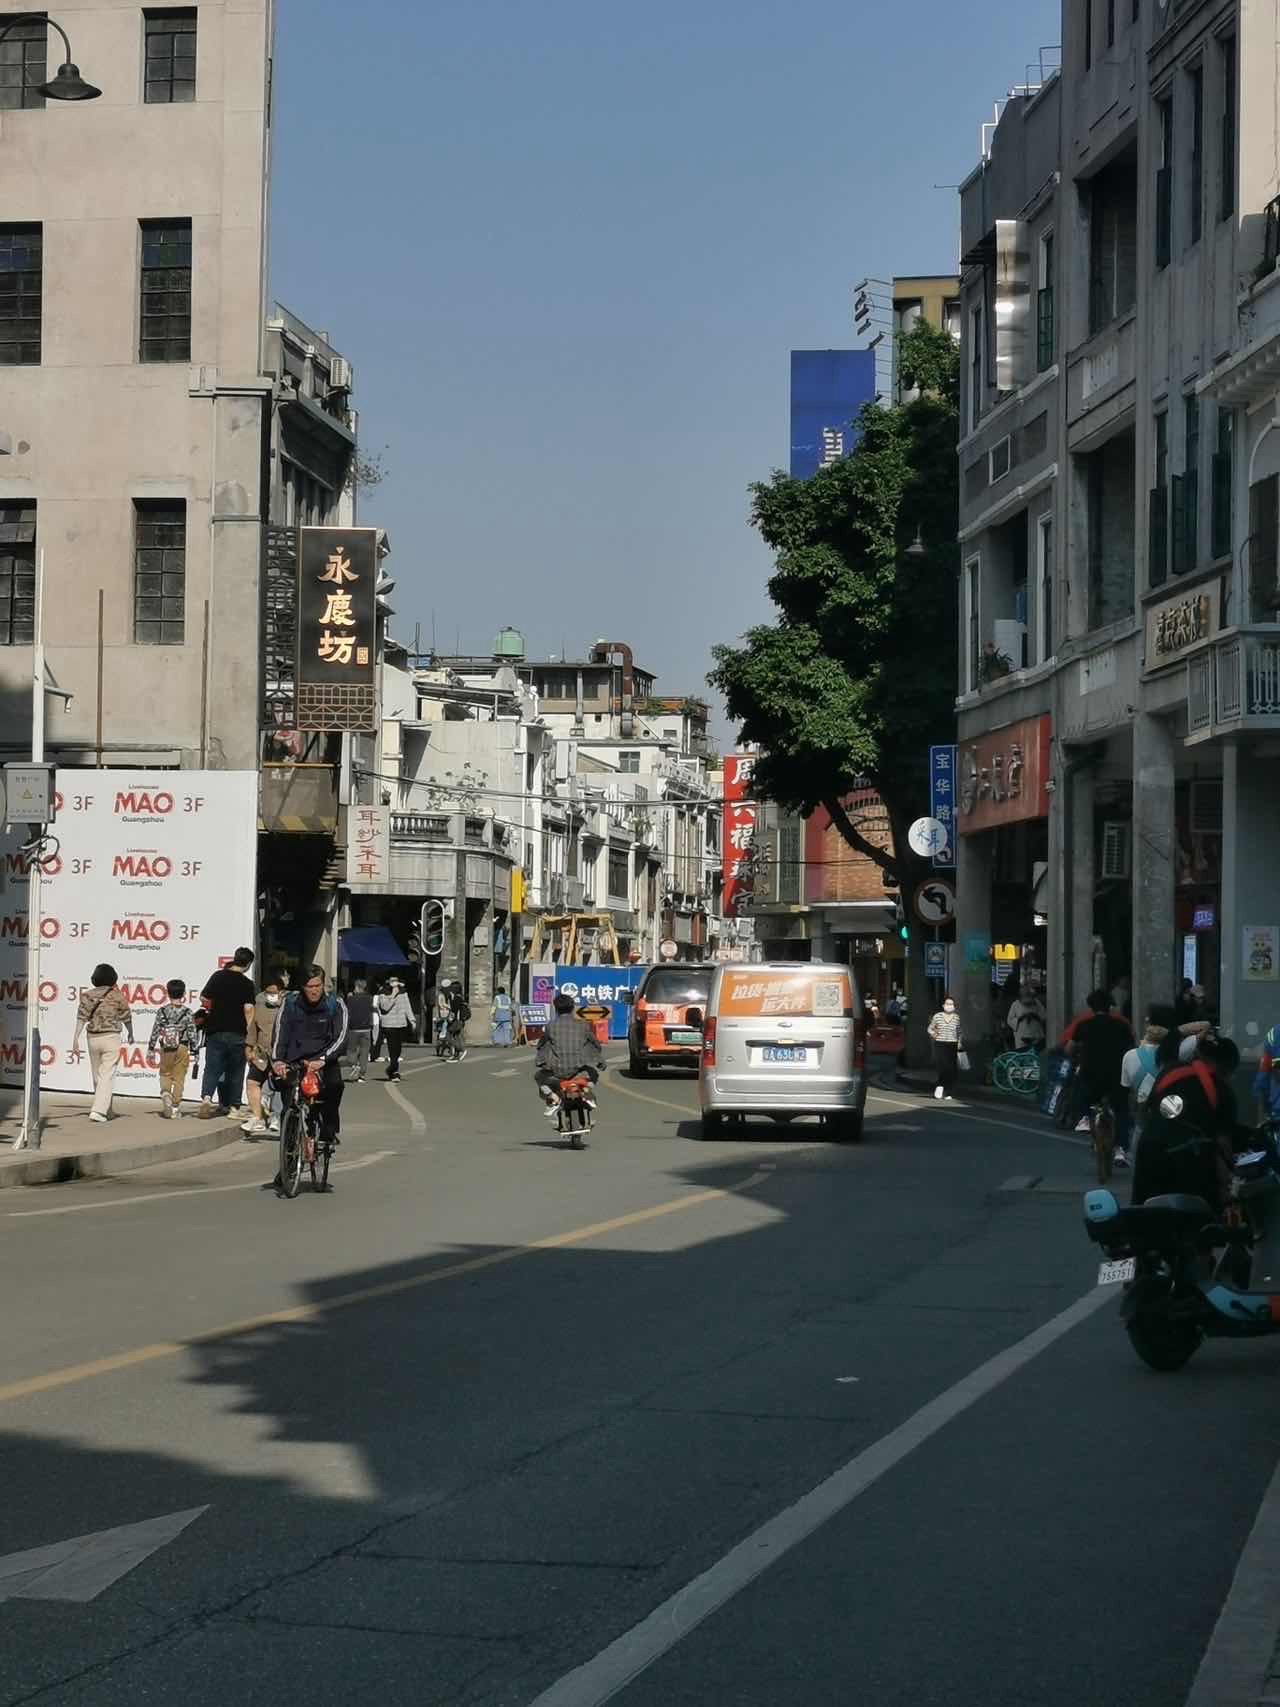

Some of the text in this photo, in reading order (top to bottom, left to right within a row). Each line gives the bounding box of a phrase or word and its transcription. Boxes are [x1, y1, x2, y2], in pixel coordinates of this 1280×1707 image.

[935, 753, 951, 820] 宝华路
[73, 796, 94, 811] 3F
[114, 792, 204, 813] MAO 3F
[122, 816, 165, 824] Guangzhou
[72, 859, 92, 874] 3F
[113, 856, 202, 877] MAO 3F
[69, 923, 90, 938] 3F
[111, 920, 200, 941] MAO 3F
[581, 984, 638, 1001] 中铁广
